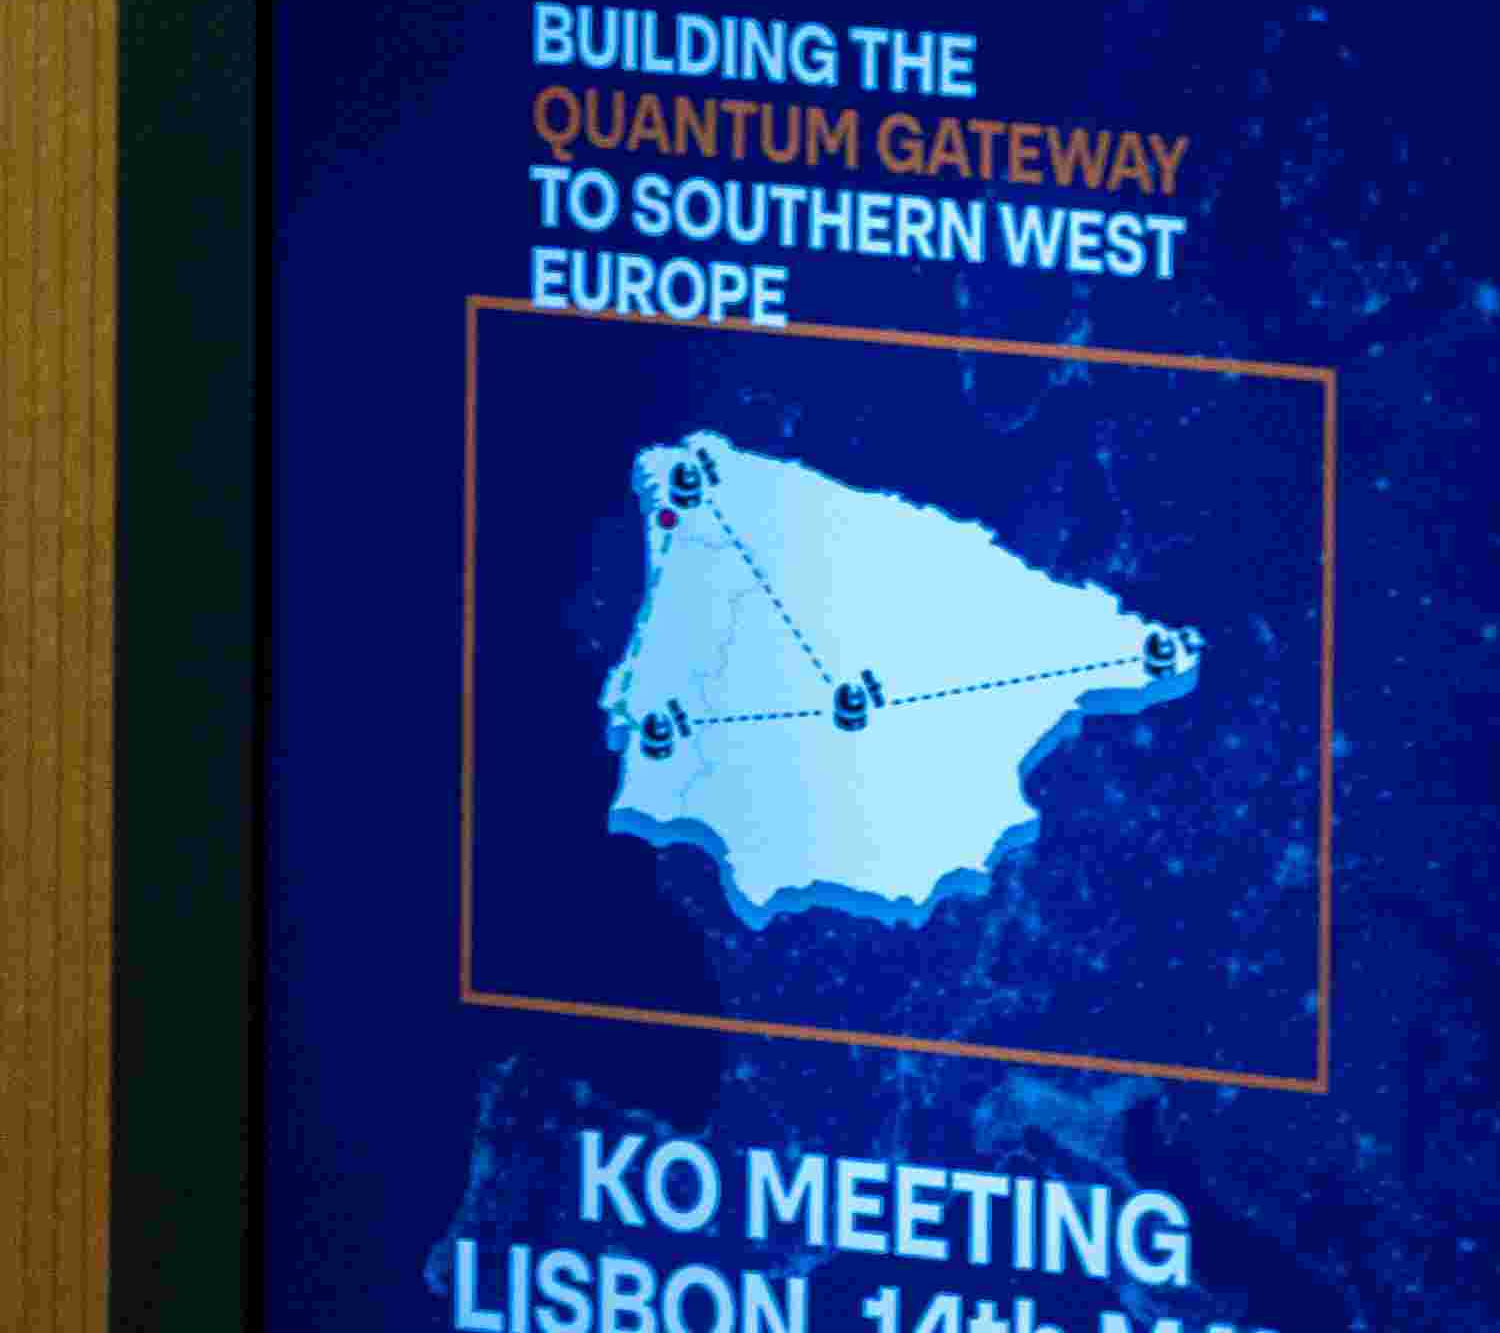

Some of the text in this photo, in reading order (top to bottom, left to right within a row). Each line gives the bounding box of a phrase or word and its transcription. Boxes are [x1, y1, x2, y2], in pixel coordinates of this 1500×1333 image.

[534, 1, 977, 98] BUILDING THE
[533, 86, 1187, 195] QUANTUM GATEWAY
[530, 165, 1187, 279] TO SOUTHERN WEST
[531, 245, 790, 330] EUROPE
[580, 1130, 1191, 1287] KO MEETING
